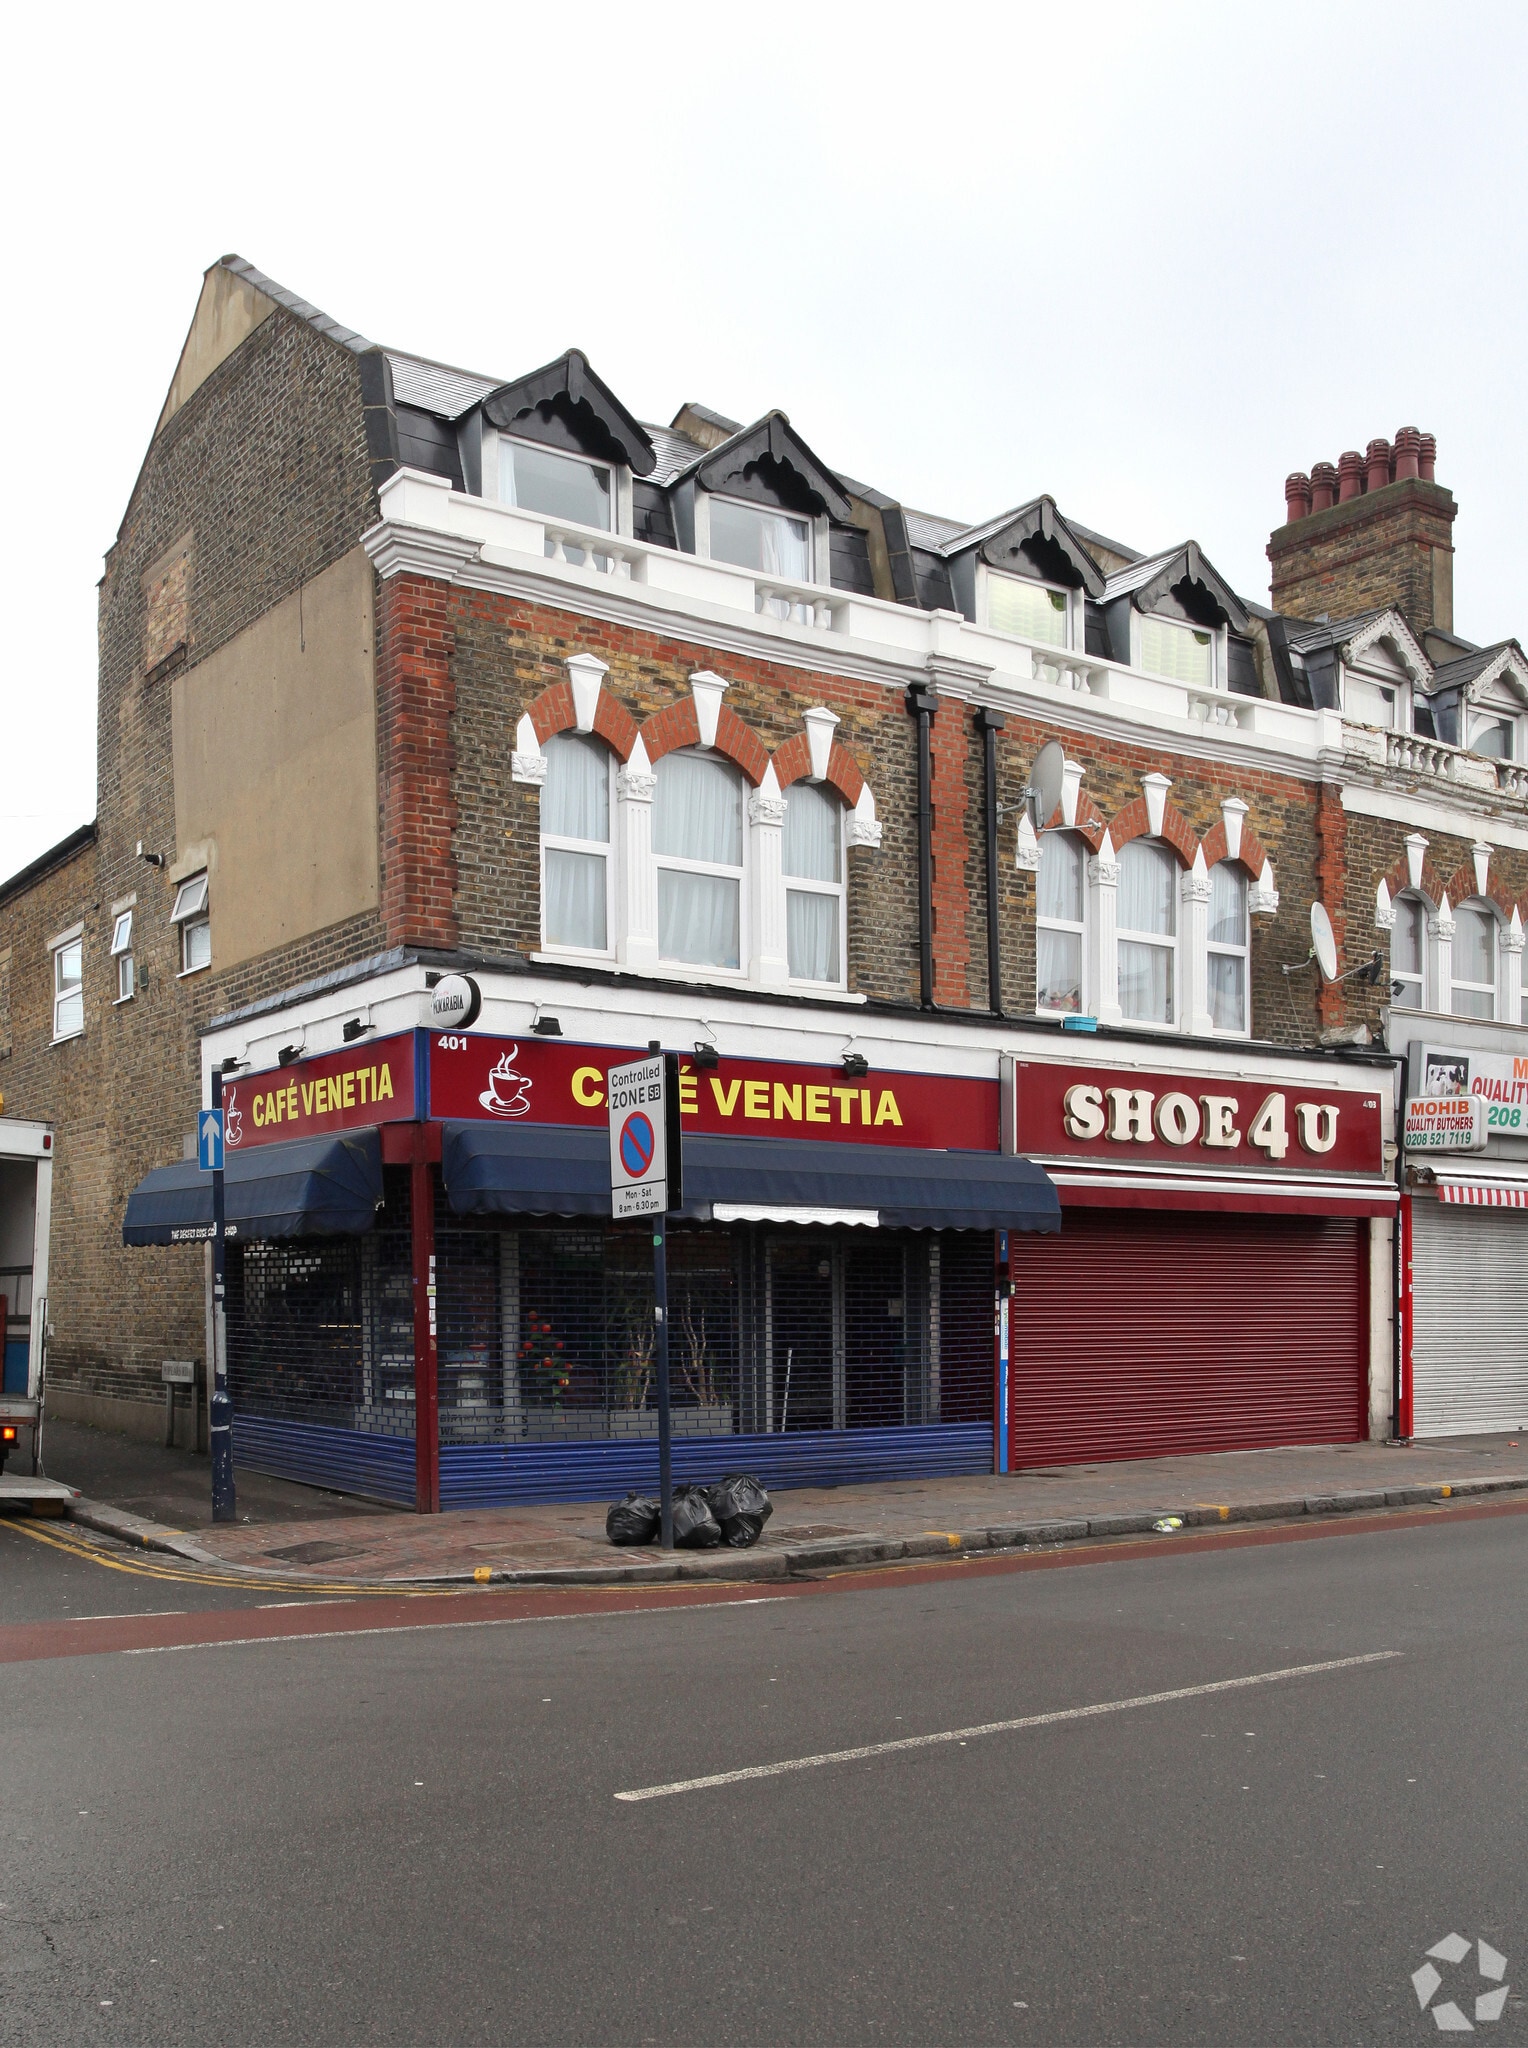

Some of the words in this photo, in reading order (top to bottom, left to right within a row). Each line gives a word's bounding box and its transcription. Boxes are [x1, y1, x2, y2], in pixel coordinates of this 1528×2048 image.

[438, 1036, 467, 1051] 401
[612, 1065, 660, 1087] Controlled
[252, 1078, 299, 1128] CAFÉ
[300, 1062, 394, 1117] VENETIA
[571, 1066, 698, 1114] CÉ
[710, 1078, 903, 1126] VENETIA
[612, 1086, 646, 1110] ZONE
[648, 1084, 661, 1102] SB
[1411, 1101, 1469, 1116] MOHIB
[1063, 1084, 1241, 1150] SHOE
[1247, 1092, 1289, 1161] 4
[1294, 1102, 1340, 1154] U
[1406, 1118, 1435, 1132] QUALITY
[1437, 1116, 1474, 1131] BUTCHERS
[1405, 1133, 1428, 1146] 0208
[1429, 1133, 1446, 1145] 521
[1449, 1131, 1472, 1145] 7119
[625, 1190, 637, 1200] Mon
[641, 1188, 652, 1198] Sat
